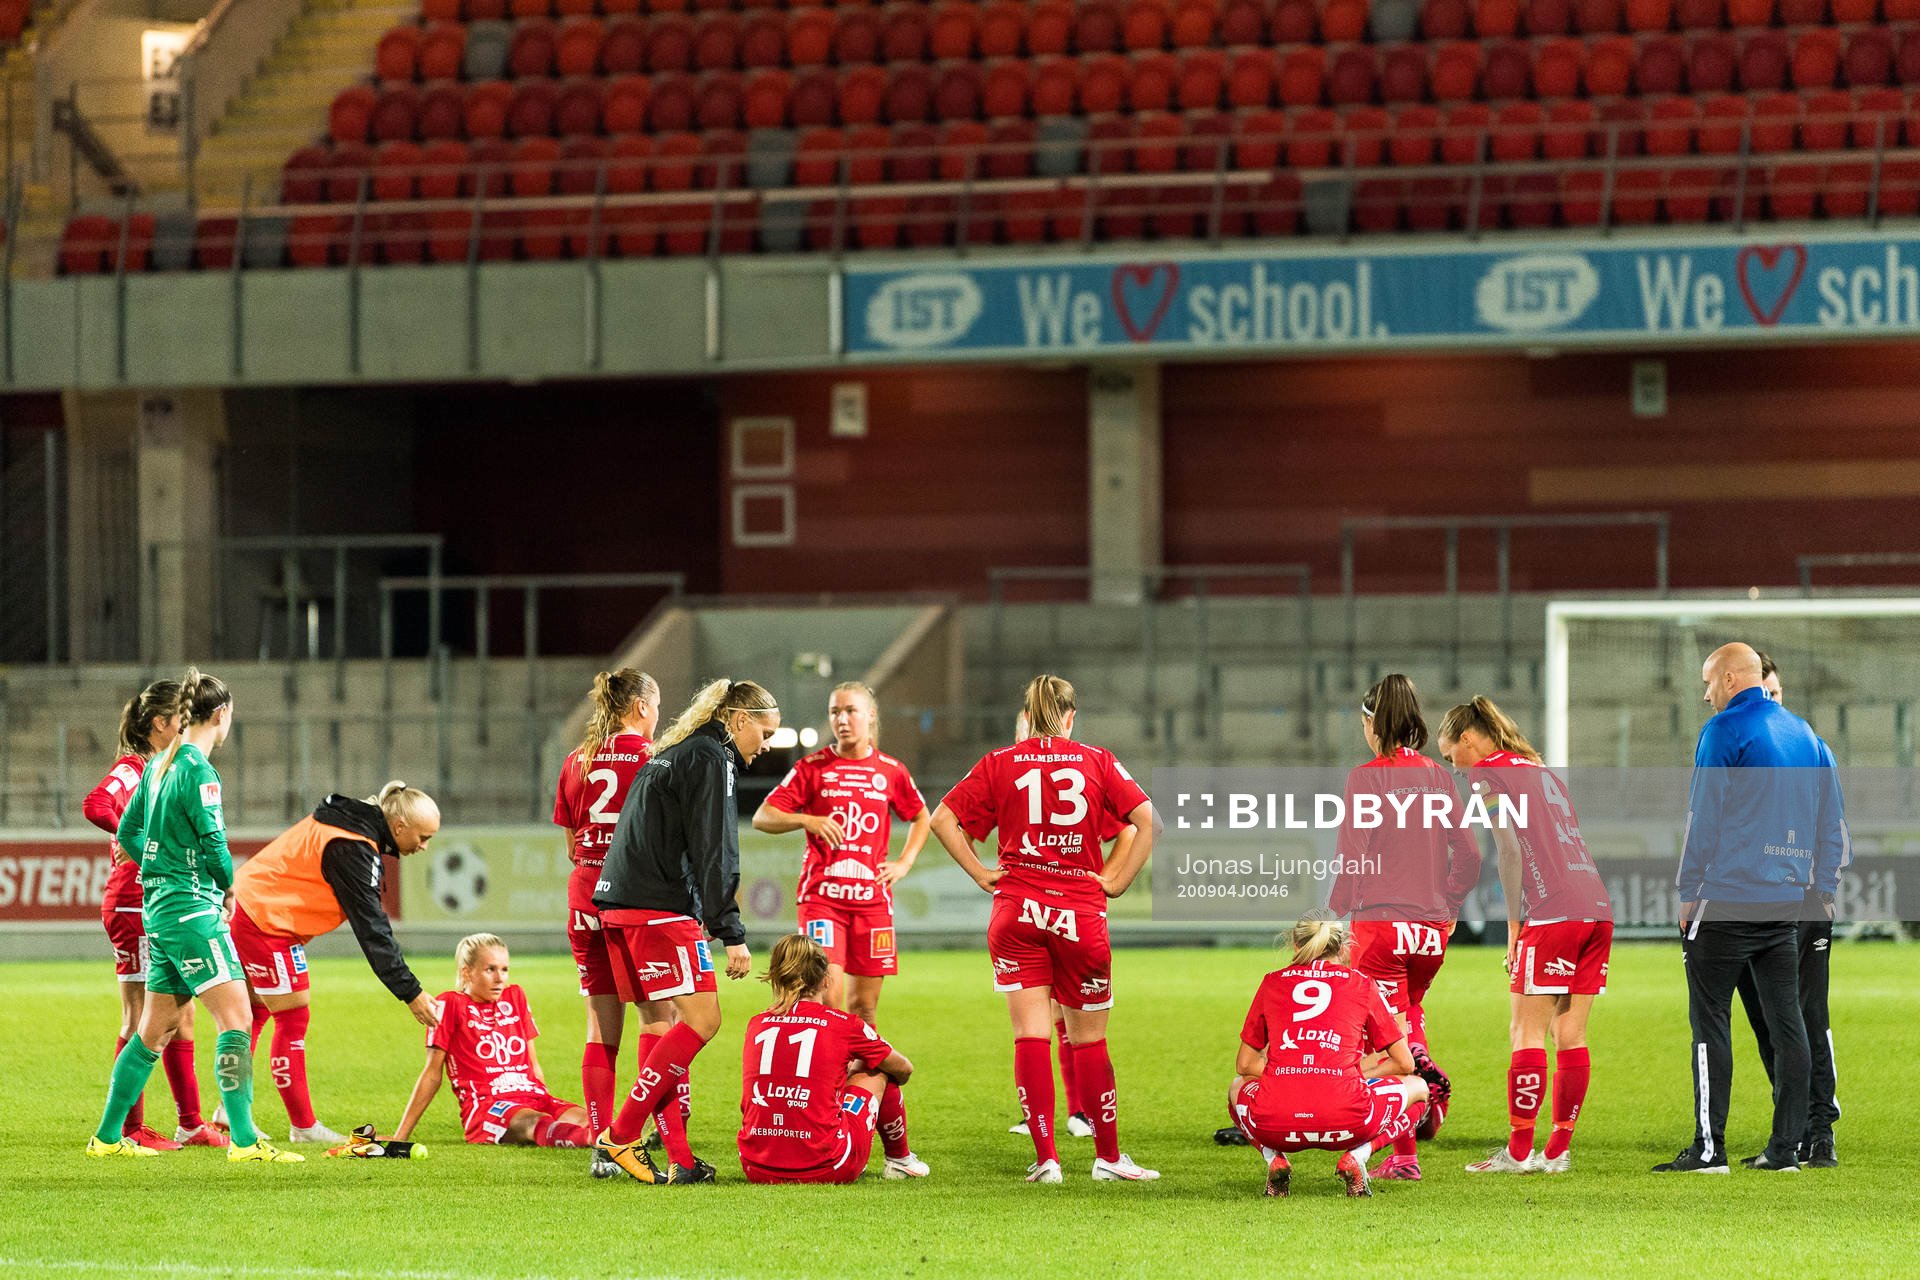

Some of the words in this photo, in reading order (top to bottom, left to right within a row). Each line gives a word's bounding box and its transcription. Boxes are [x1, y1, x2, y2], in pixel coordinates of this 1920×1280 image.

[1505, 271, 1579, 313] IST
[1637, 255, 1726, 332] We
[893, 286, 961, 333] IST
[1018, 273, 1103, 349] We
[1189, 261, 1390, 345] school.
[1014, 753, 1084, 763] MALMBERGS
[587, 768, 621, 824] 2
[1014, 767, 1089, 827] 13
[1541, 771, 1572, 818] 4
[1039, 831, 1083, 847] Loxia
[1060, 845, 1082, 856] group
[818, 881, 874, 901] renta
[1018, 897, 1081, 943] NA
[1392, 921, 1444, 957] NA
[639, 968, 672, 982] elgruppen
[1281, 970, 1350, 979] MALMBERGS
[1544, 966, 1576, 977] elgruppen
[1291, 979, 1333, 1023] 9
[761, 1016, 828, 1027] MALMBERGS
[475, 1031, 526, 1065] ÖBO
[1297, 1027, 1342, 1045] Loxia
[1319, 1042, 1340, 1053] group
[754, 1026, 818, 1078] 11
[1275, 1066, 1343, 1077] ÖREBROPORTEN
[767, 1082, 811, 1102] Loxia
[590, 1100, 600, 1131] umbro
[787, 1100, 809, 1110] group
[1038, 1113, 1049, 1138] umbro
